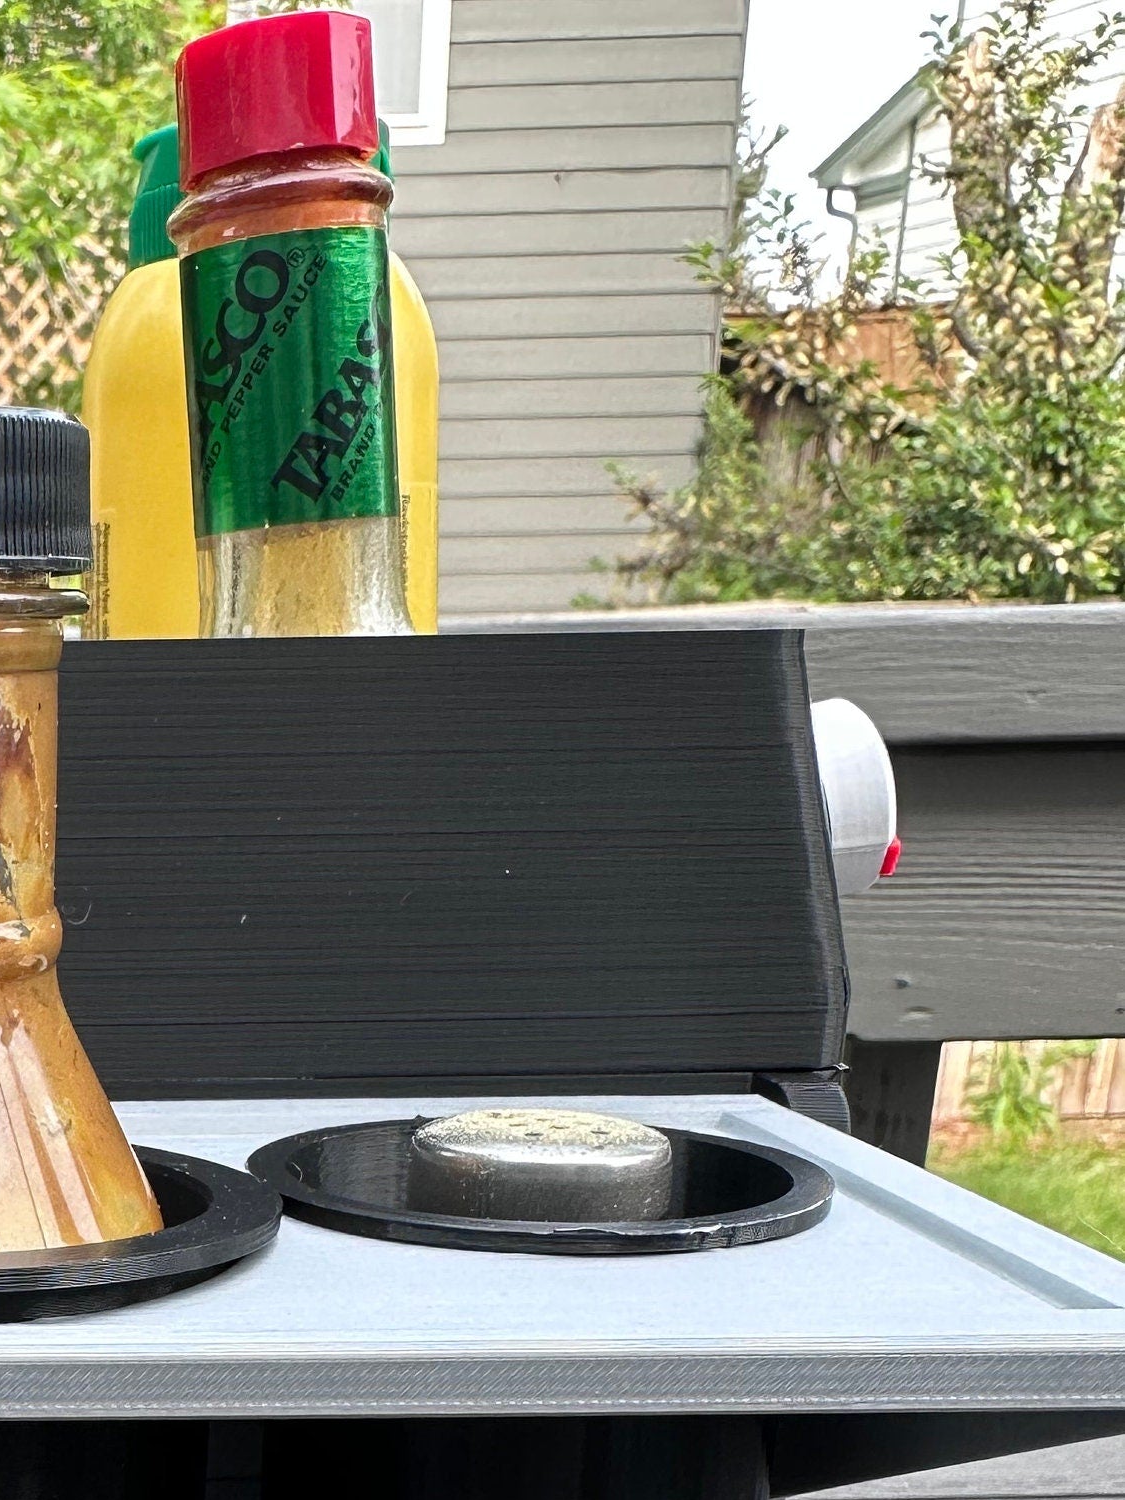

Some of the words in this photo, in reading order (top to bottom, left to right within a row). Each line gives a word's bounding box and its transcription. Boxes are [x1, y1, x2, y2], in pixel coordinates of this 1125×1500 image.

[220, 342, 275, 434] PEPPER
[272, 250, 327, 337] SAUCE
[330, 422, 376, 502] BRAND
